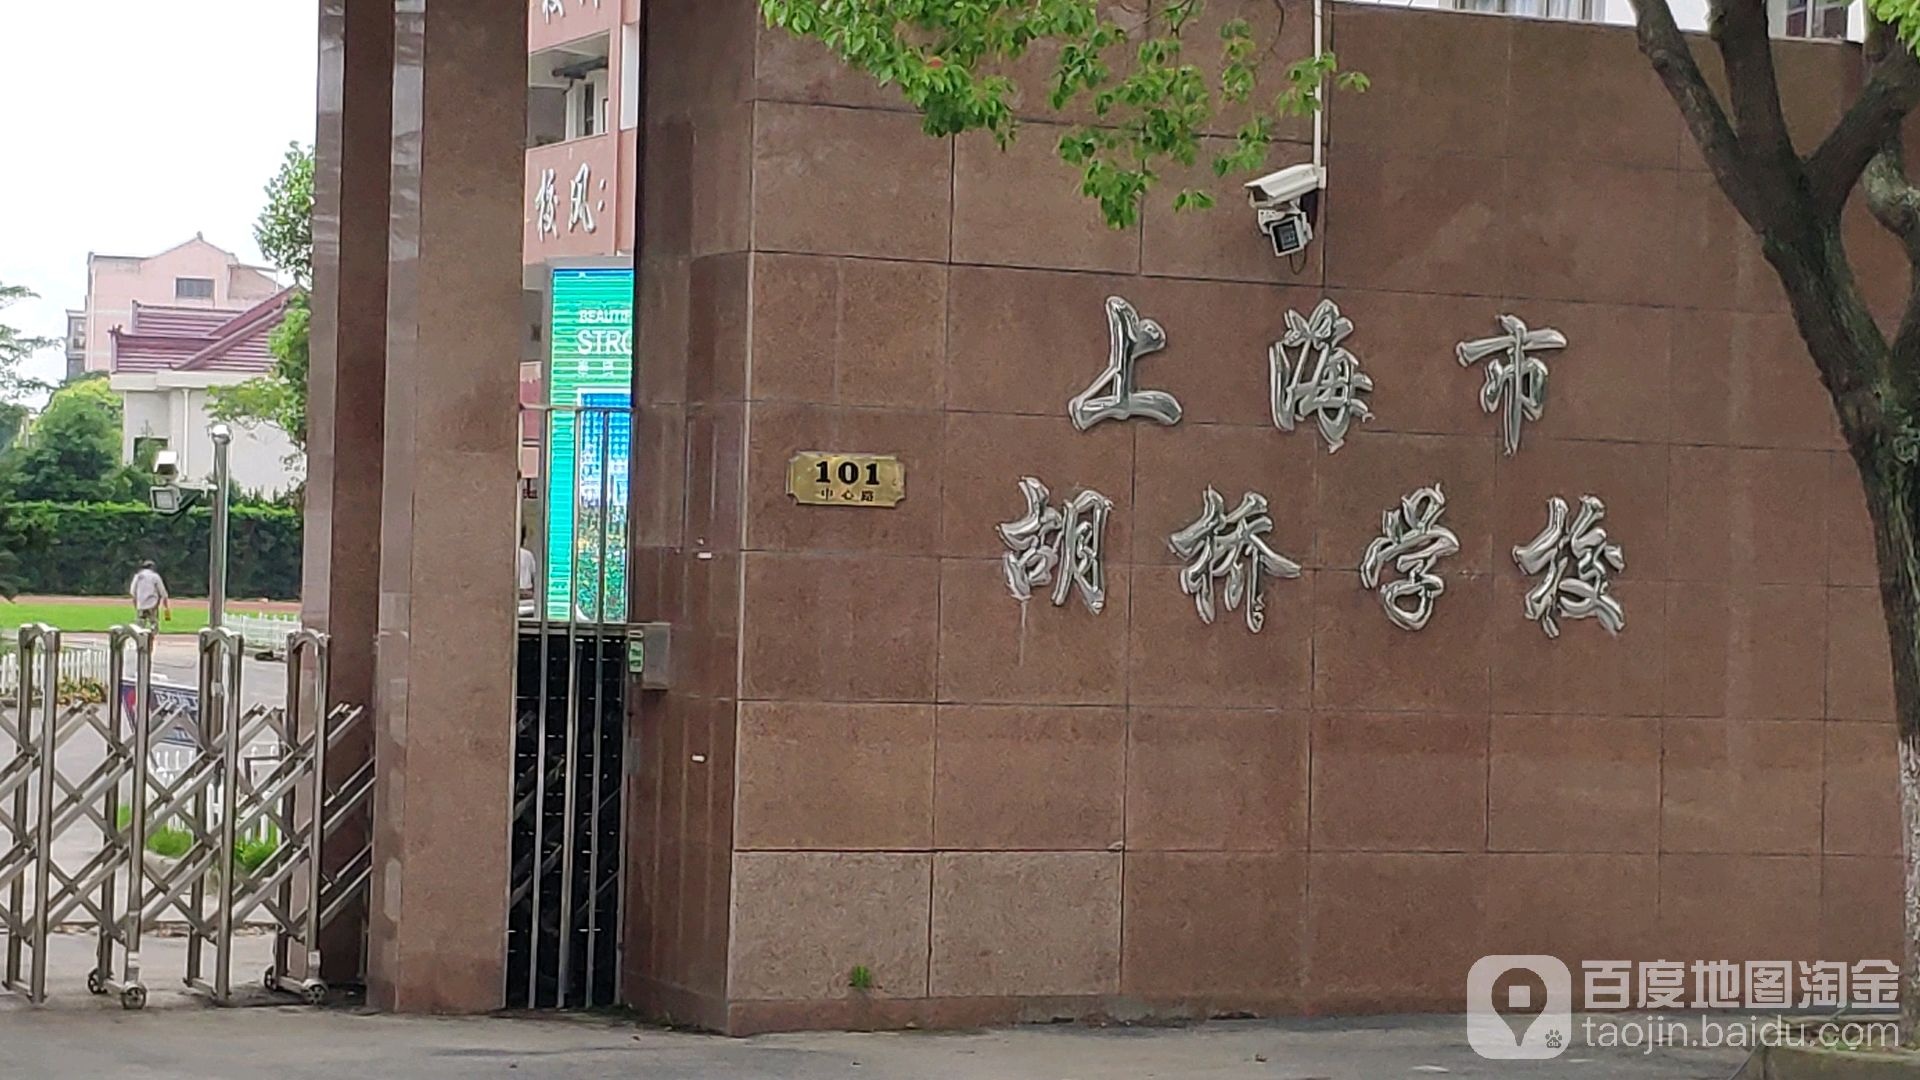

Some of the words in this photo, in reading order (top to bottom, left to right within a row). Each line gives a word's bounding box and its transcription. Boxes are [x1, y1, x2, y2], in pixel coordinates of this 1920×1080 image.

[1068, 296, 1567, 455] 上海市
[815, 461, 880, 485] 101
[821, 488, 874, 502] 中心路
[997, 476, 1626, 638] 胡桥学校
